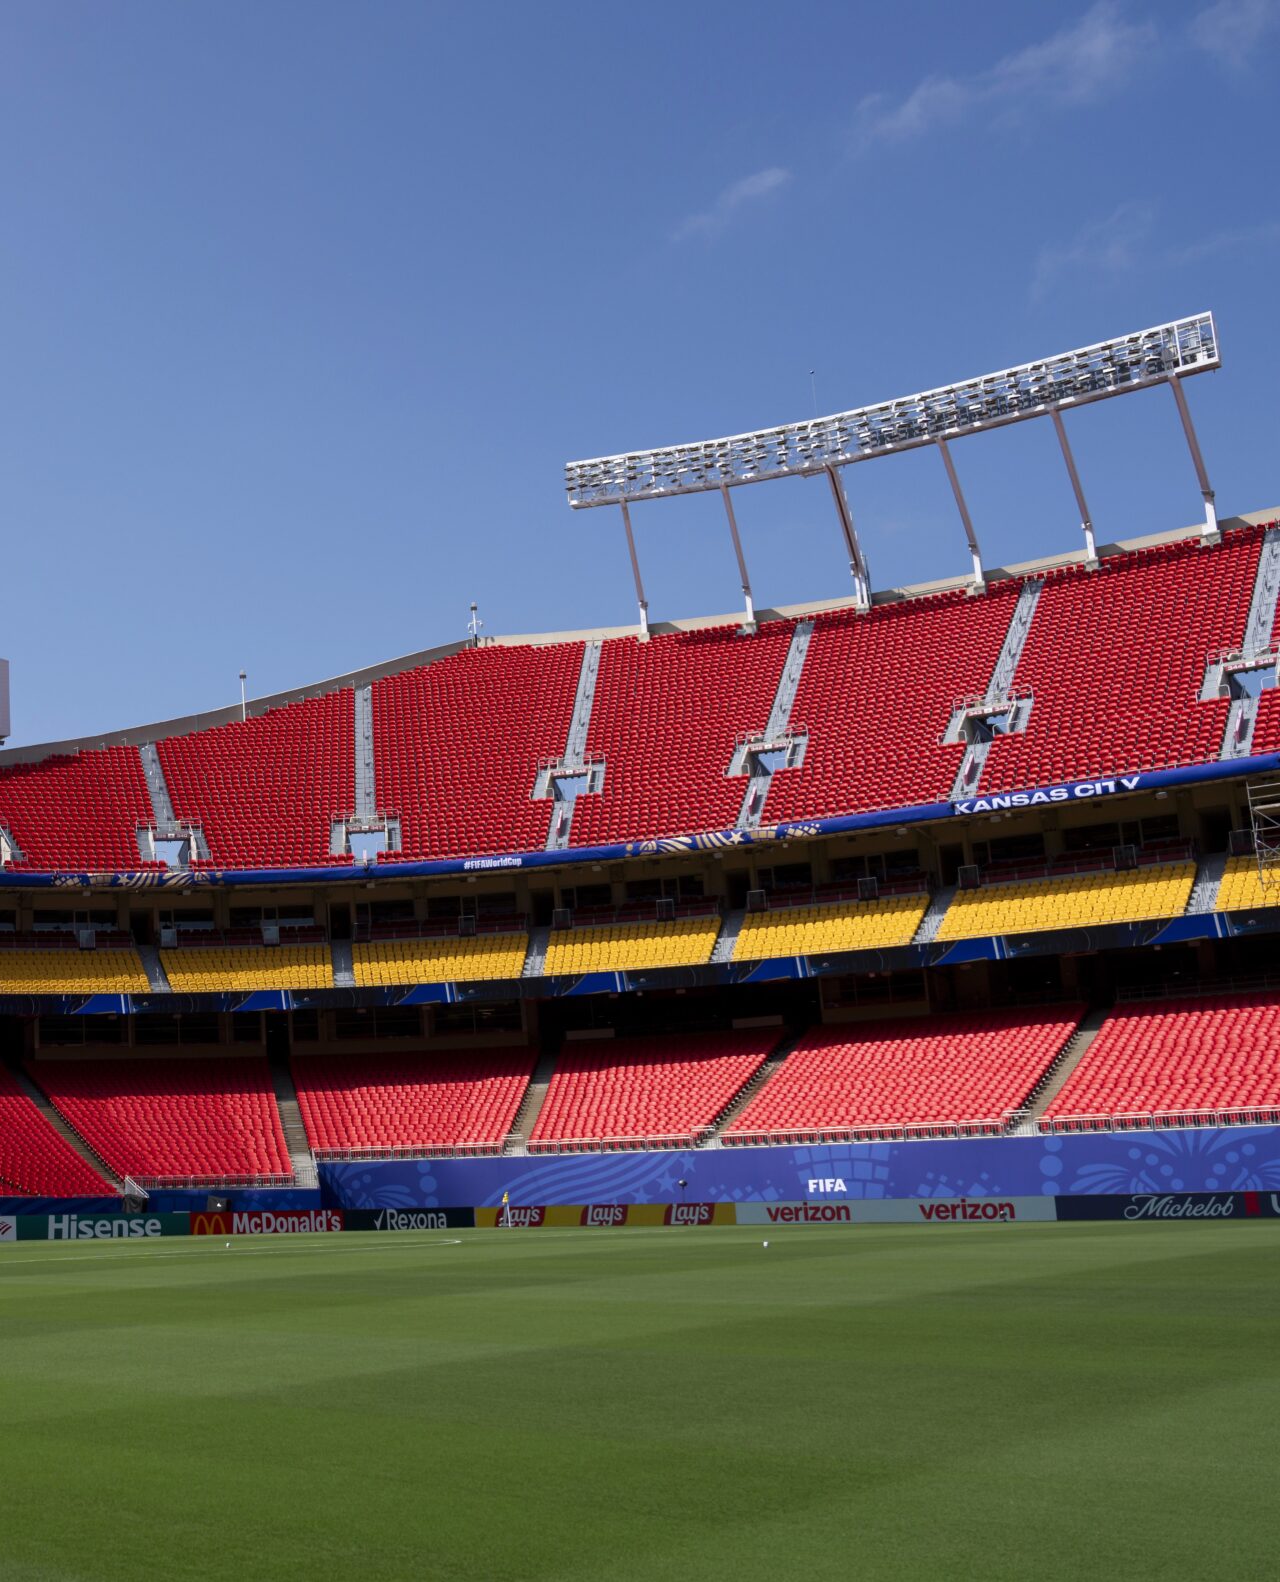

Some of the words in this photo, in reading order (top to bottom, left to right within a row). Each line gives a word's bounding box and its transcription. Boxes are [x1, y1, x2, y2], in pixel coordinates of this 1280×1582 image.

[955, 788, 1069, 815] KANSAS
[1074, 776, 1140, 798] CITY
[463, 857, 522, 869] #FIFAWorldCup
[808, 1178, 848, 1193] FIFA
[500, 1206, 540, 1227] Lay's
[586, 1204, 623, 1226] Lay's
[670, 1203, 709, 1225] Lay's
[766, 1202, 851, 1222] verizon
[918, 1198, 1016, 1220] verizon
[1124, 1194, 1234, 1220] Michelob
[48, 1214, 162, 1240] Hisense
[233, 1210, 341, 1234] McDonald's
[387, 1209, 447, 1231] Rexona
